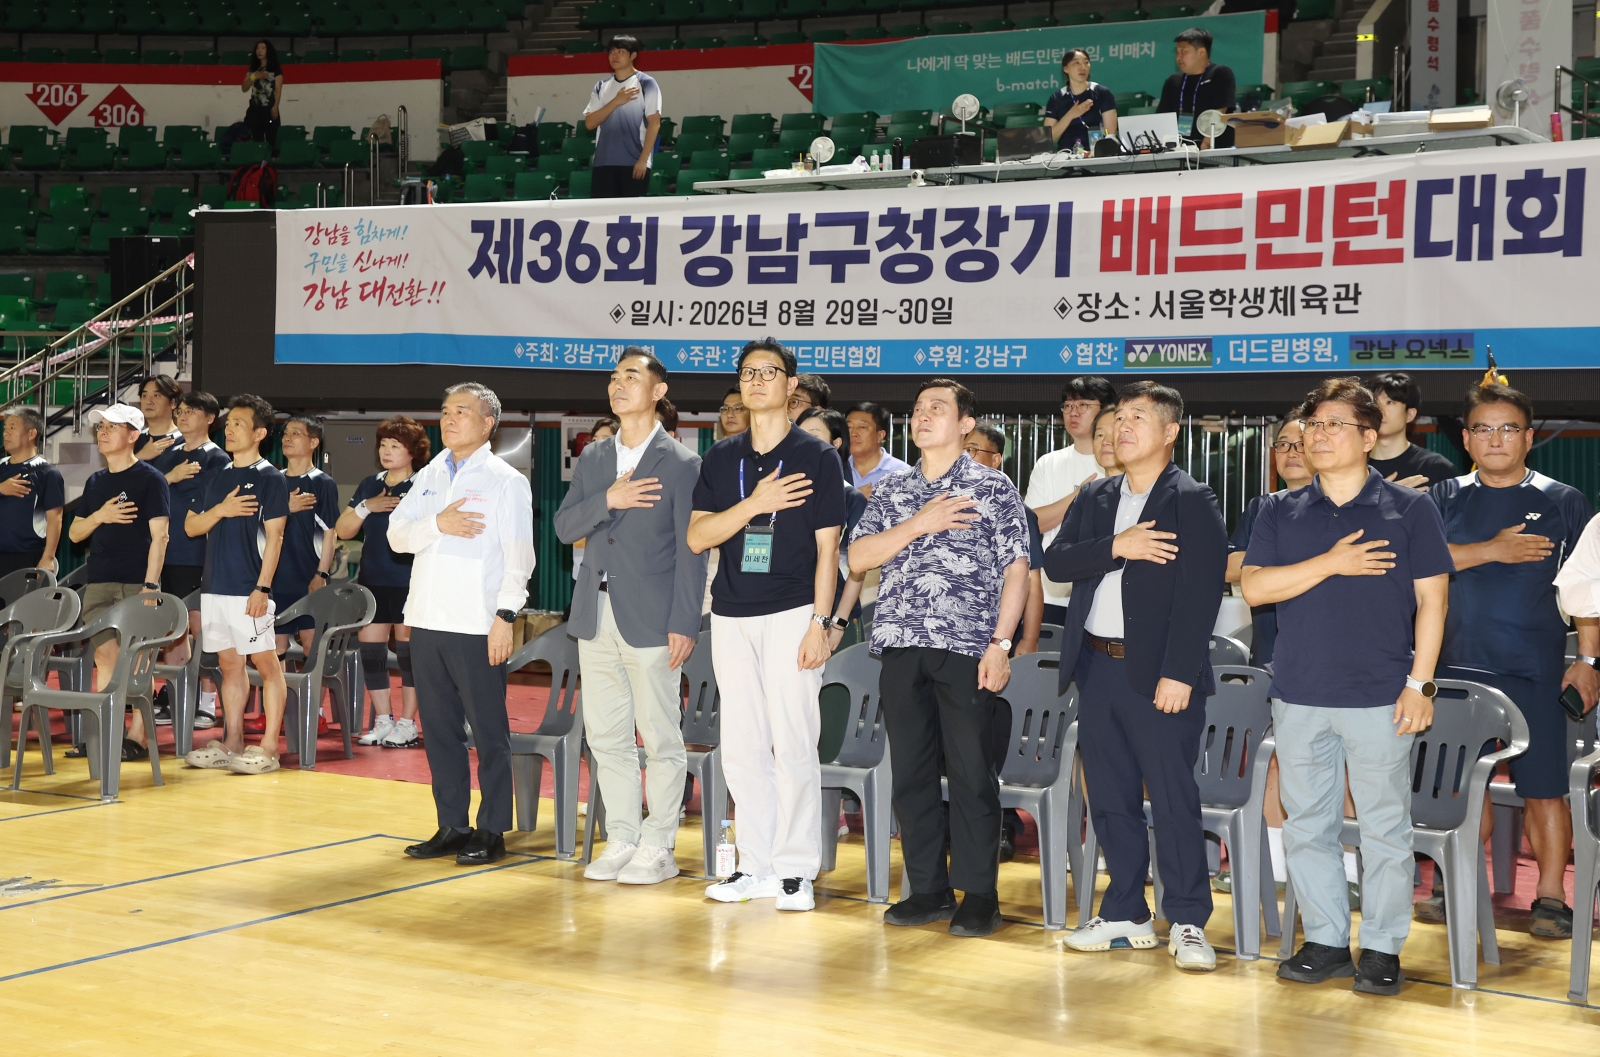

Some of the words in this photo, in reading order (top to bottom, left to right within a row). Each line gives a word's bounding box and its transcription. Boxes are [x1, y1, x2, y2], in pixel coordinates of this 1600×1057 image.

[907, 55, 951, 73] 나에게
[954, 54, 969, 70] 딱
[973, 53, 1002, 70] 맞는
[1006, 47, 1066, 66] 배드민턴
[1109, 42, 1156, 59] 비매치
[36, 84, 78, 107] 206
[996, 74, 1059, 92] b-match
[98, 103, 140, 126] 306
[304, 222, 351, 246] 강남을
[353, 218, 408, 246] 힘차게!
[467, 215, 660, 286] 제36회
[679, 200, 1074, 288] 강남구청장기
[304, 252, 348, 276] 구민을
[352, 249, 409, 273] 신나게!
[303, 277, 352, 312] 강남
[358, 275, 446, 308] 대전환!!
[1148, 281, 1362, 321] 서울학생체육관
[778, 298, 816, 327] 8월
[825, 296, 953, 327] 29일~30일
[974, 344, 1028, 368] 강남구
[1076, 342, 1118, 366] 협찬:
[1157, 343, 1207, 362] YONEX
[1229, 337, 1339, 364] 더드림병원,
[1355, 339, 1399, 360] 강남
[1404, 338, 1470, 360] 요넥스
